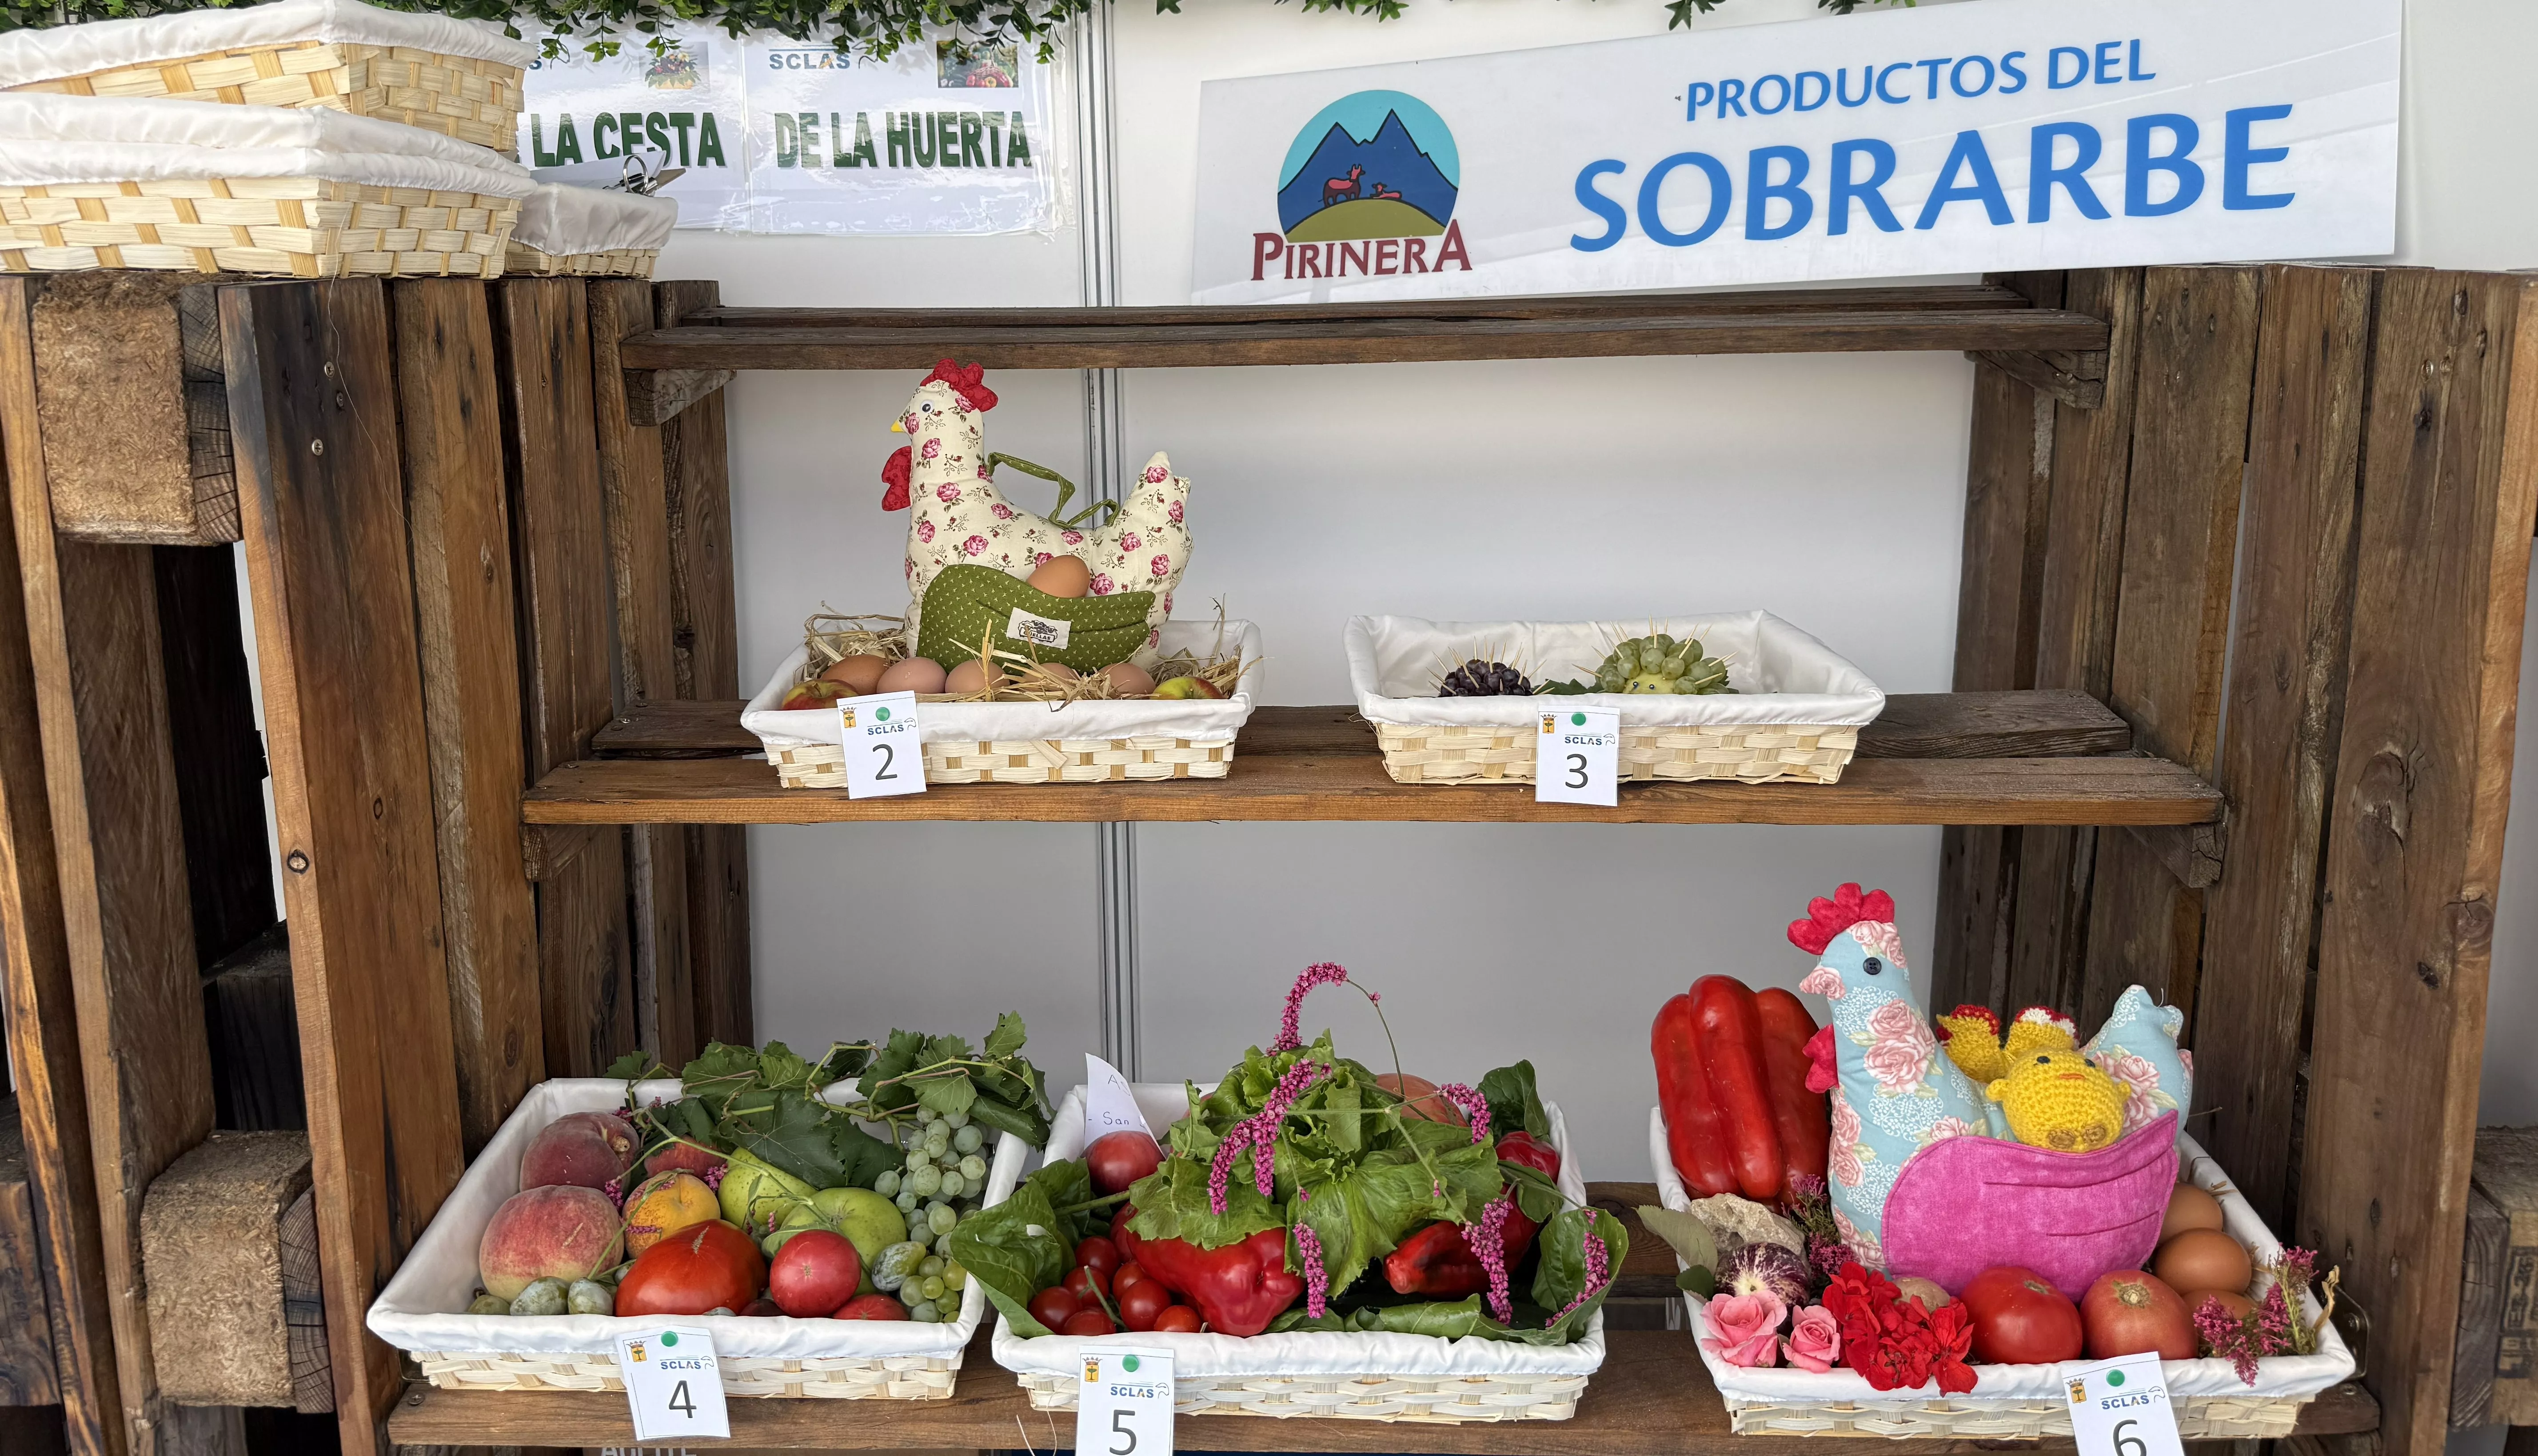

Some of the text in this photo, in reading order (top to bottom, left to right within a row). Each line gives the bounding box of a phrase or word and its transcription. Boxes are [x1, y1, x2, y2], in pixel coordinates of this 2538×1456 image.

[769, 53, 850, 70] SCLAS
[1687, 39, 2156, 122] PRODUCTOS DEL
[531, 112, 726, 167] LA CESTA
[774, 111, 1033, 168] DE LA HUERTA
[1571, 104, 2296, 252] SOBRARBE
[1251, 219, 1473, 281] PIRINERA
[867, 724, 904, 735] SCLAS
[1564, 736, 1602, 746] SCLAS
[873, 744, 898, 780] 2
[1565, 754, 1588, 789] 3
[660, 1360, 701, 1370] SCLAS
[668, 1380, 697, 1419] 4
[1110, 1386, 1154, 1398] SCLAS
[2101, 1395, 2150, 1410] SCLAS
[1109, 1409, 1137, 1456] 5
[2113, 1419, 2147, 1456] 6
